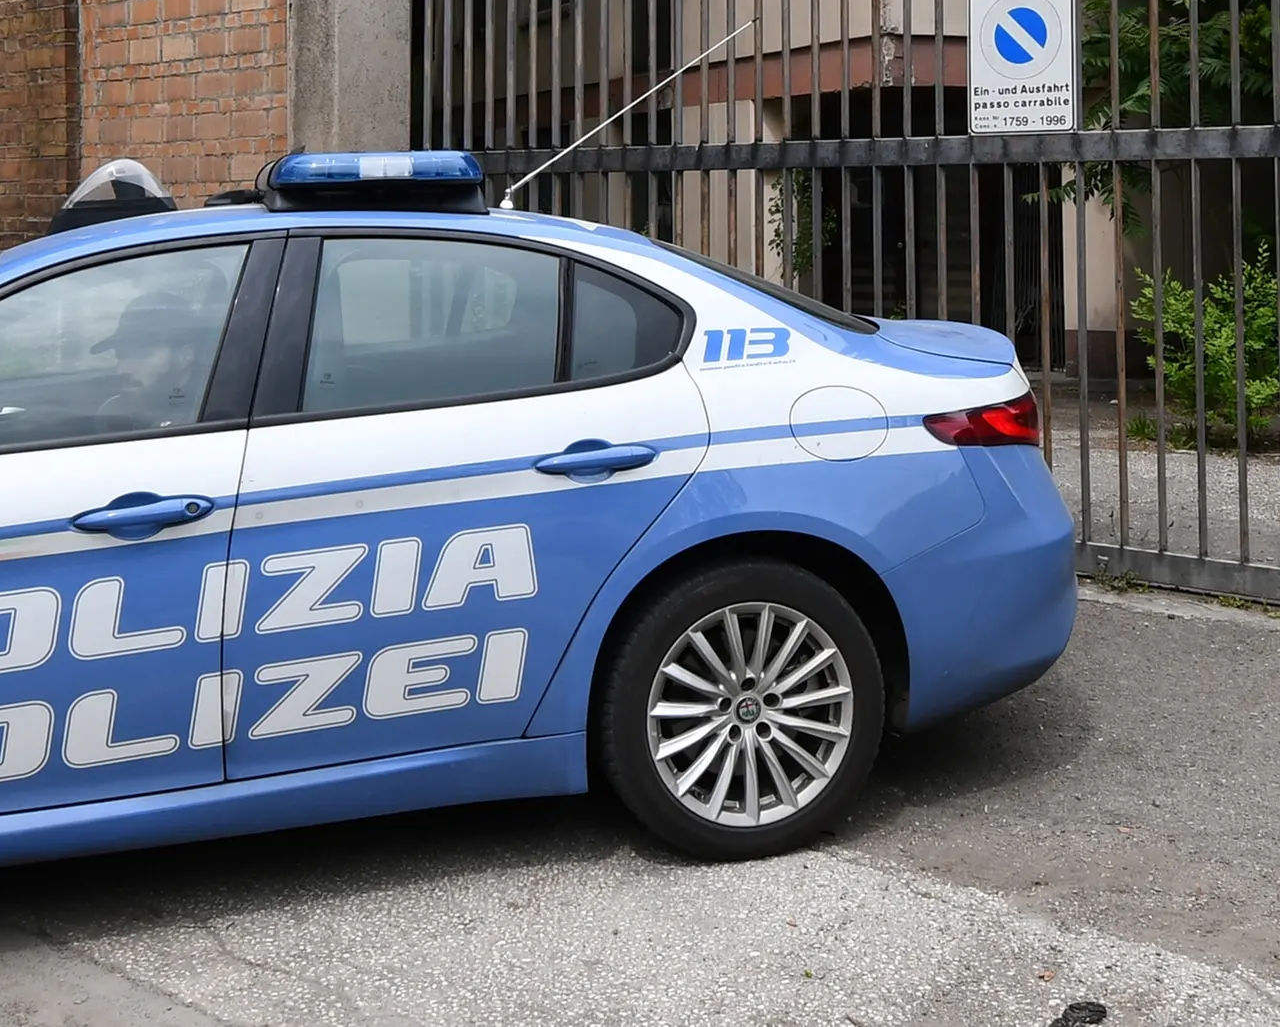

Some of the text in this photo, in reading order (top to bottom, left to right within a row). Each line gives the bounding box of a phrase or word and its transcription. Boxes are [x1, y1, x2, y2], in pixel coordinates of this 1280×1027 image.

[974, 86, 990, 96] Ein
[998, 85, 1018, 95] und
[1020, 83, 1070, 94] Ausfahrt
[974, 97, 1070, 111] passo carrabile
[1003, 116, 1029, 127] 1759
[1040, 115, 1067, 126] 1996
[703, 327, 791, 362] 113
